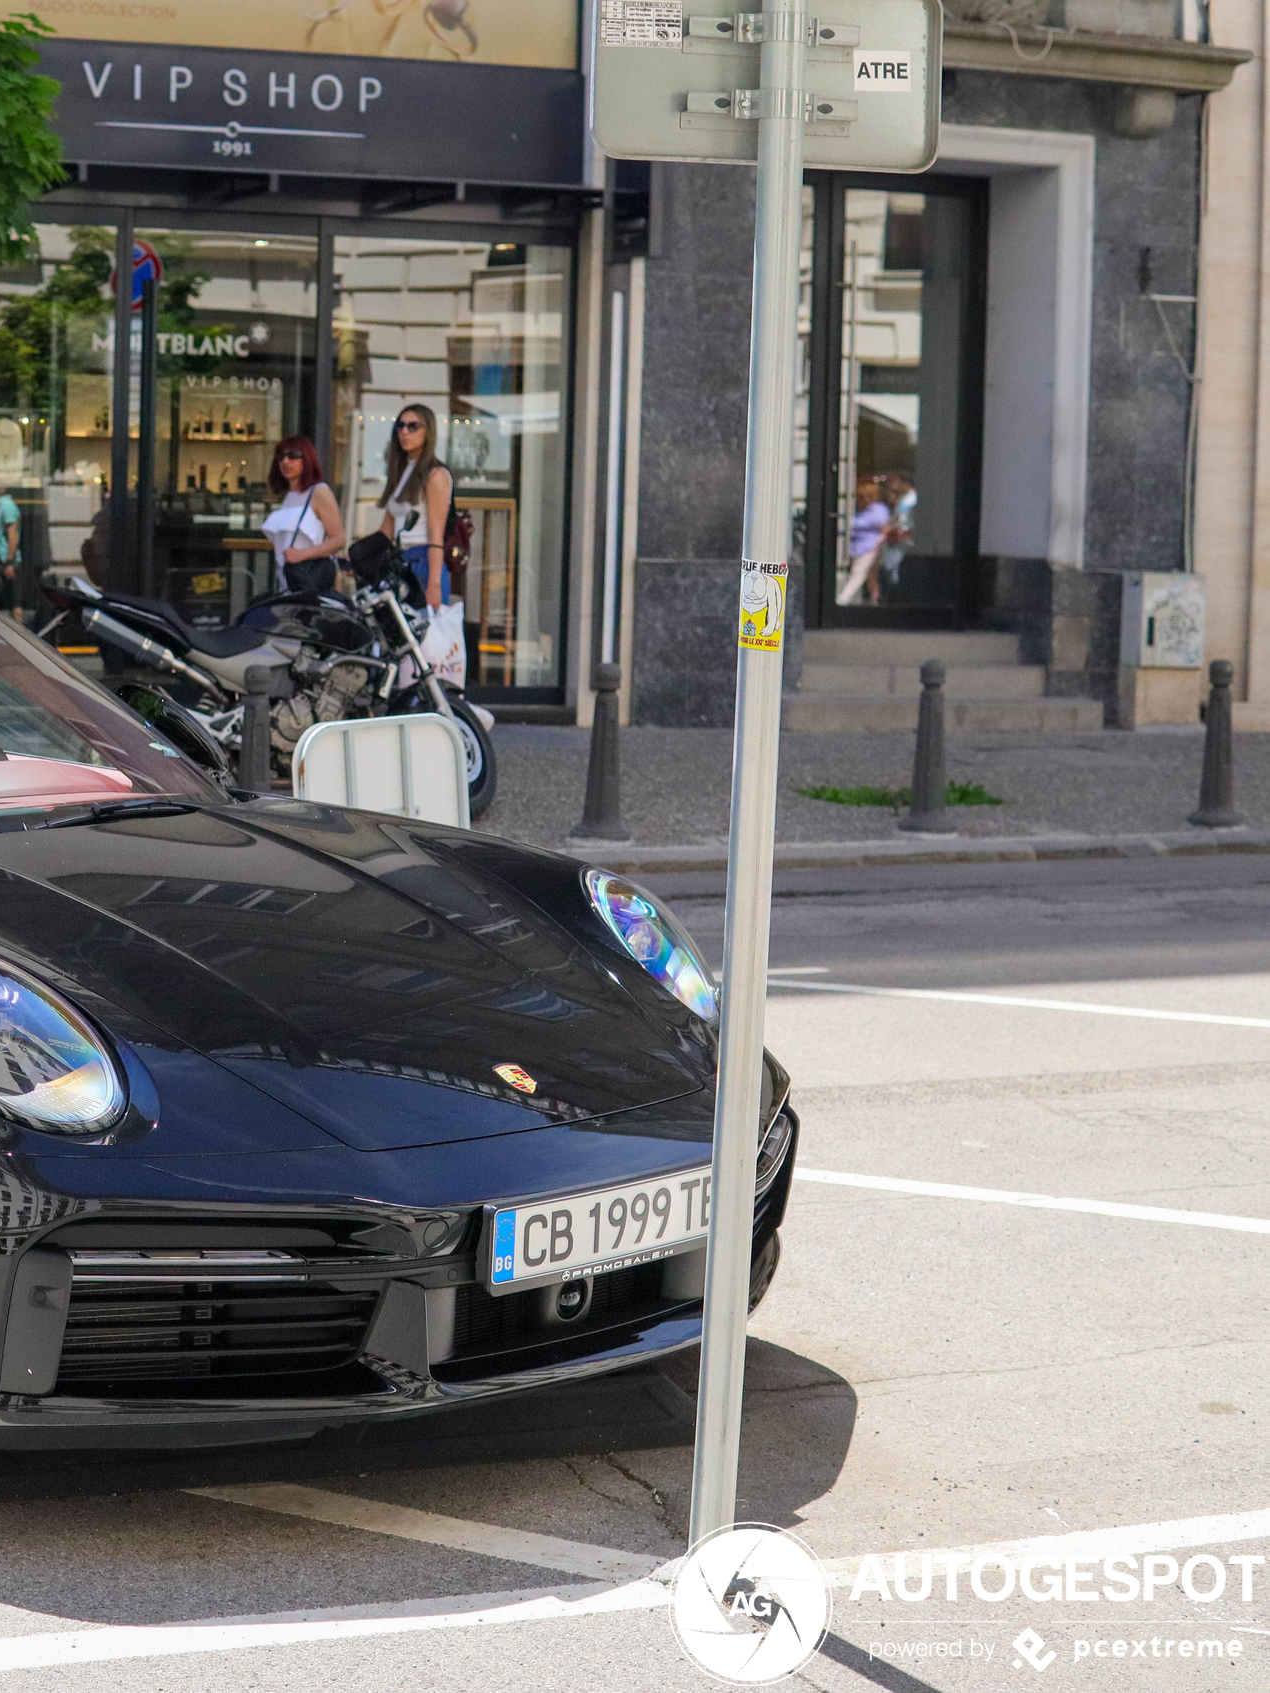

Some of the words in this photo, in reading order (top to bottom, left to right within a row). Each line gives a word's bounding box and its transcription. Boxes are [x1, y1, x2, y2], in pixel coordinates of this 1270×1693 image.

[78, 3, 176, 18] COLLECTION
[857, 62, 908, 79] ATRE
[82, 60, 193, 102] VIP
[223, 69, 382, 112] SHOP
[211, 140, 252, 156] 1991
[186, 374, 222, 389] VIP
[230, 375, 282, 391] SHOP
[523, 1209, 573, 1267] CB
[589, 1187, 672, 1254] 1999
[494, 1255, 513, 1273] BG
